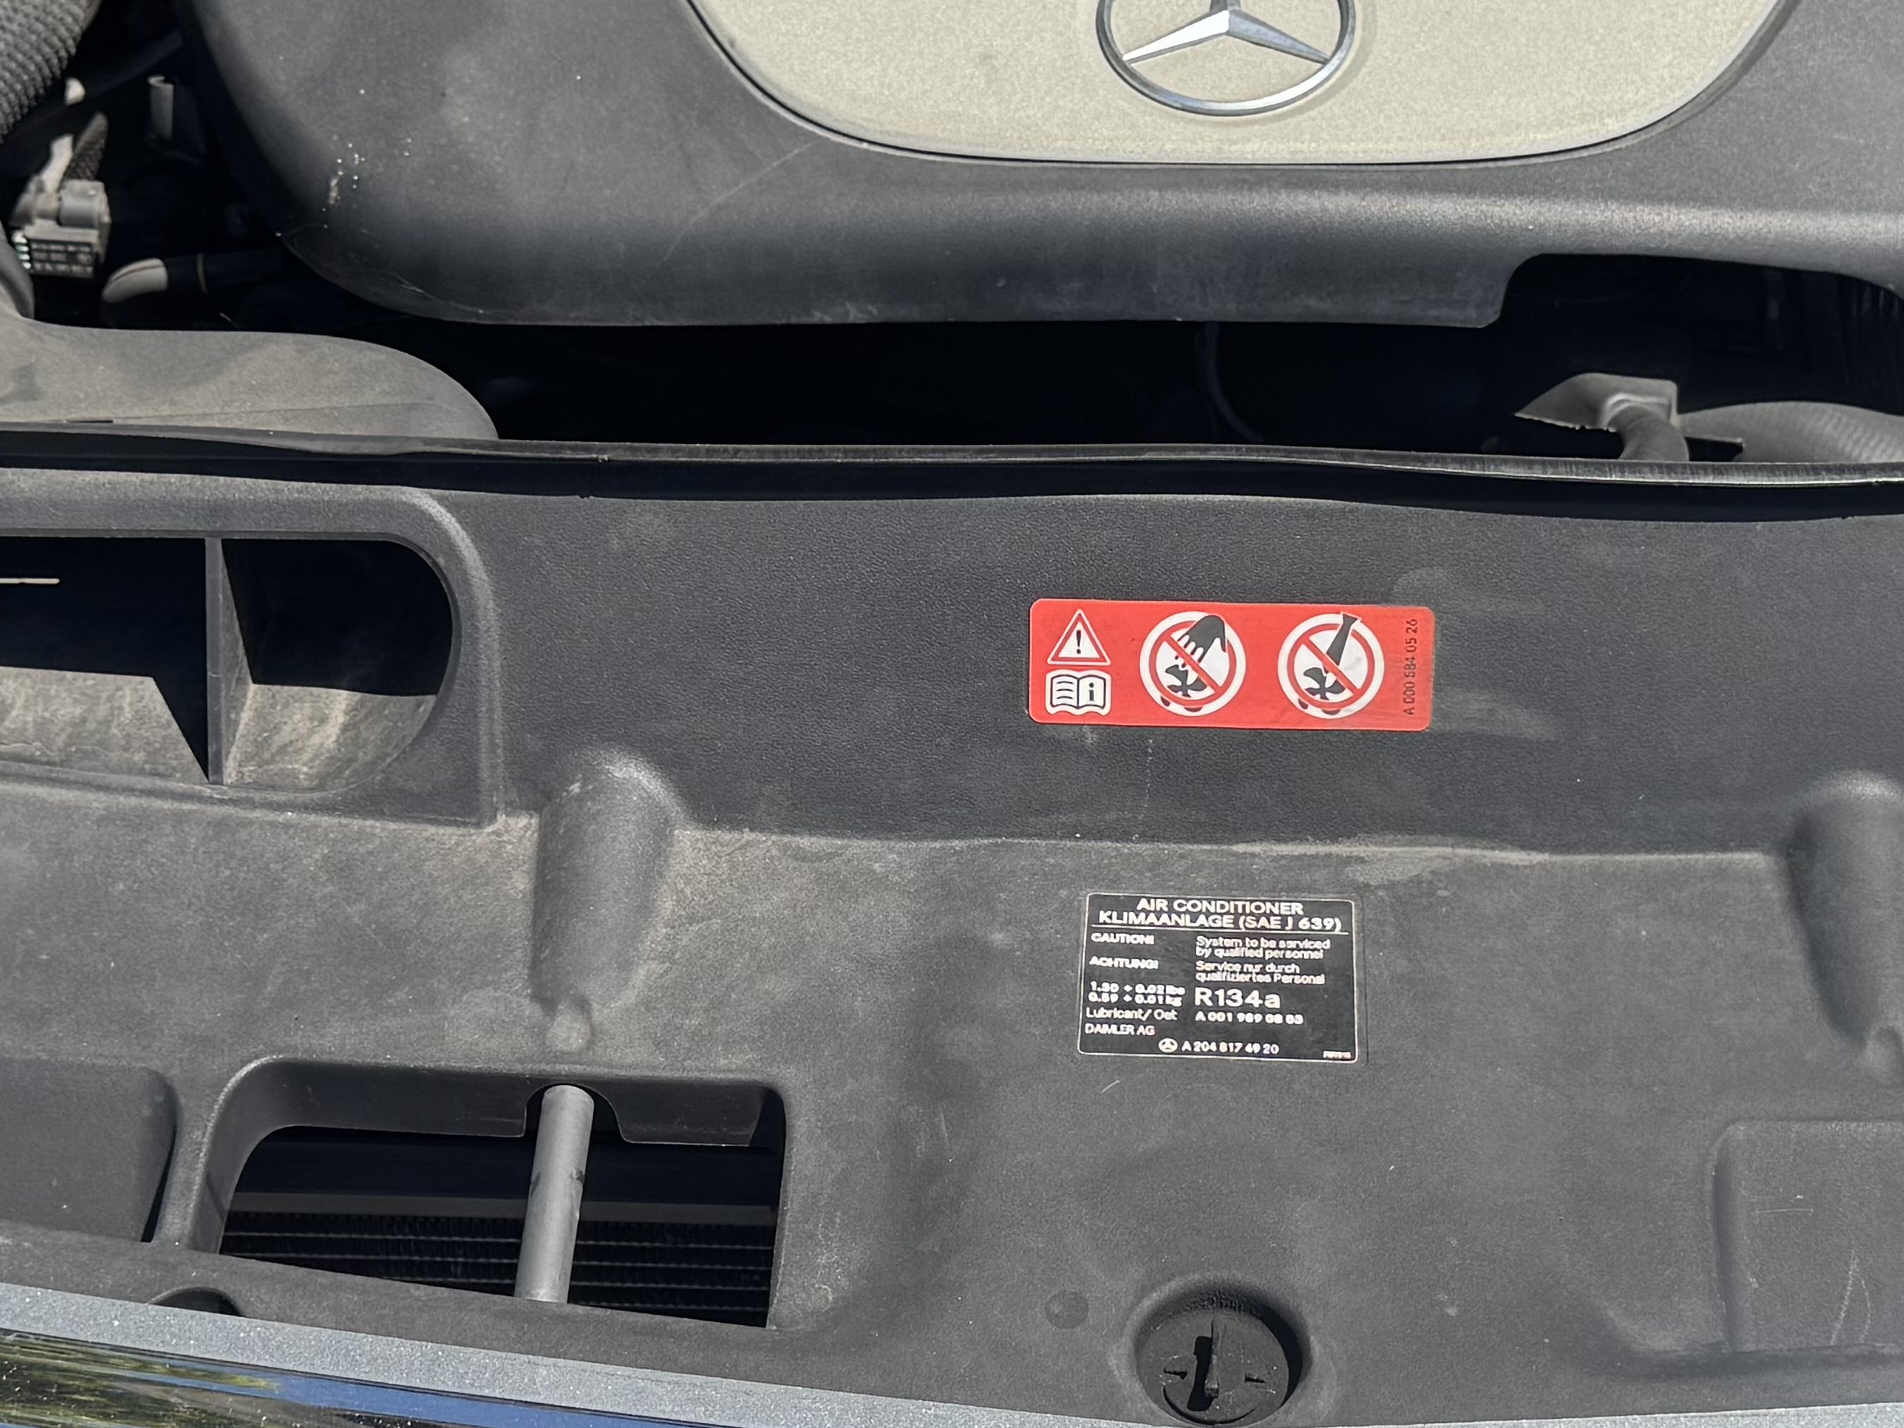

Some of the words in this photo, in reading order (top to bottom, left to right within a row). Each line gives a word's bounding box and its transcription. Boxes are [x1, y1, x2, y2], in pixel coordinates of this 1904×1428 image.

[1405, 618, 1418, 634] 26
[1404, 637, 1417, 653] 05
[1402, 681, 1416, 704] 000
[1402, 707, 1415, 716] A
[1136, 897, 1169, 912] AIR
[1172, 898, 1305, 916] CONDITIONER
[1098, 910, 1235, 929] KLIMAANLAGE
[1238, 915, 1282, 931] (SAE
[1284, 916, 1294, 931] J
[1298, 916, 1343, 934] 639)
[1196, 935, 1243, 949] System
[1246, 937, 1259, 948] to
[1260, 937, 1277, 949] be
[1278, 938, 1332, 950] serviced
[1196, 947, 1212, 959] by
[1214, 947, 1264, 959] qualified
[1265, 949, 1324, 961] personnel
[1196, 960, 1242, 972] Service
[1243, 963, 1263, 973] nur
[1265, 962, 1300, 974] durch
[1196, 971, 1272, 983] qualifiziertes
[1273, 972, 1326, 985] Personal
[1194, 987, 1281, 1009] R134a
[1195, 1010, 1207, 1022] A
[1207, 1012, 1234, 1023] 001
[1084, 1023, 1135, 1035] DAIMLER
[1136, 1024, 1156, 1036] AG
[1181, 1040, 1192, 1052] A
[1193, 1040, 1218, 1052] 204
[1262, 1043, 1280, 1055] 20
